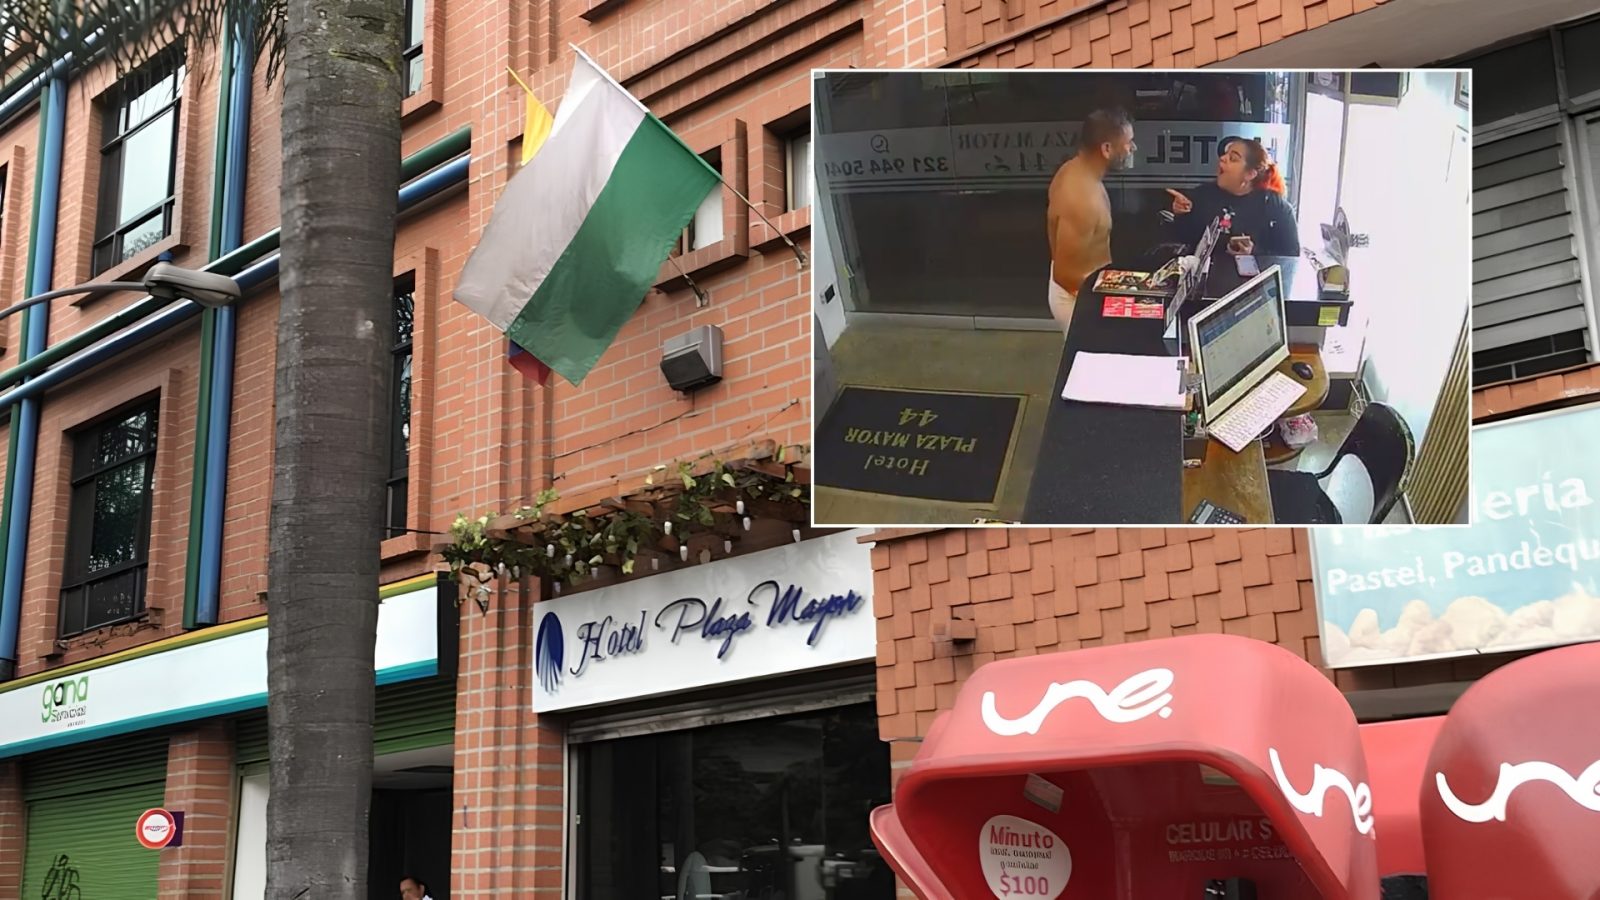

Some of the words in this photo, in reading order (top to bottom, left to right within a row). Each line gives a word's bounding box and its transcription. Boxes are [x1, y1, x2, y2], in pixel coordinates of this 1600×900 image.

[898, 408, 939, 427] 44
[844, 427, 911, 448] MAYOR
[916, 434, 978, 453] PLAZA
[864, 454, 930, 476] Hotel
[1327, 556, 1437, 595] Pastel,
[569, 609, 648, 676] Hotel
[655, 597, 753, 660] Plaza
[747, 580, 863, 646] Mayor
[41, 676, 89, 723] gana
[990, 825, 1054, 849] Minuto
[1165, 820, 1253, 844] CELULAR
[1000, 871, 1049, 897] $100
